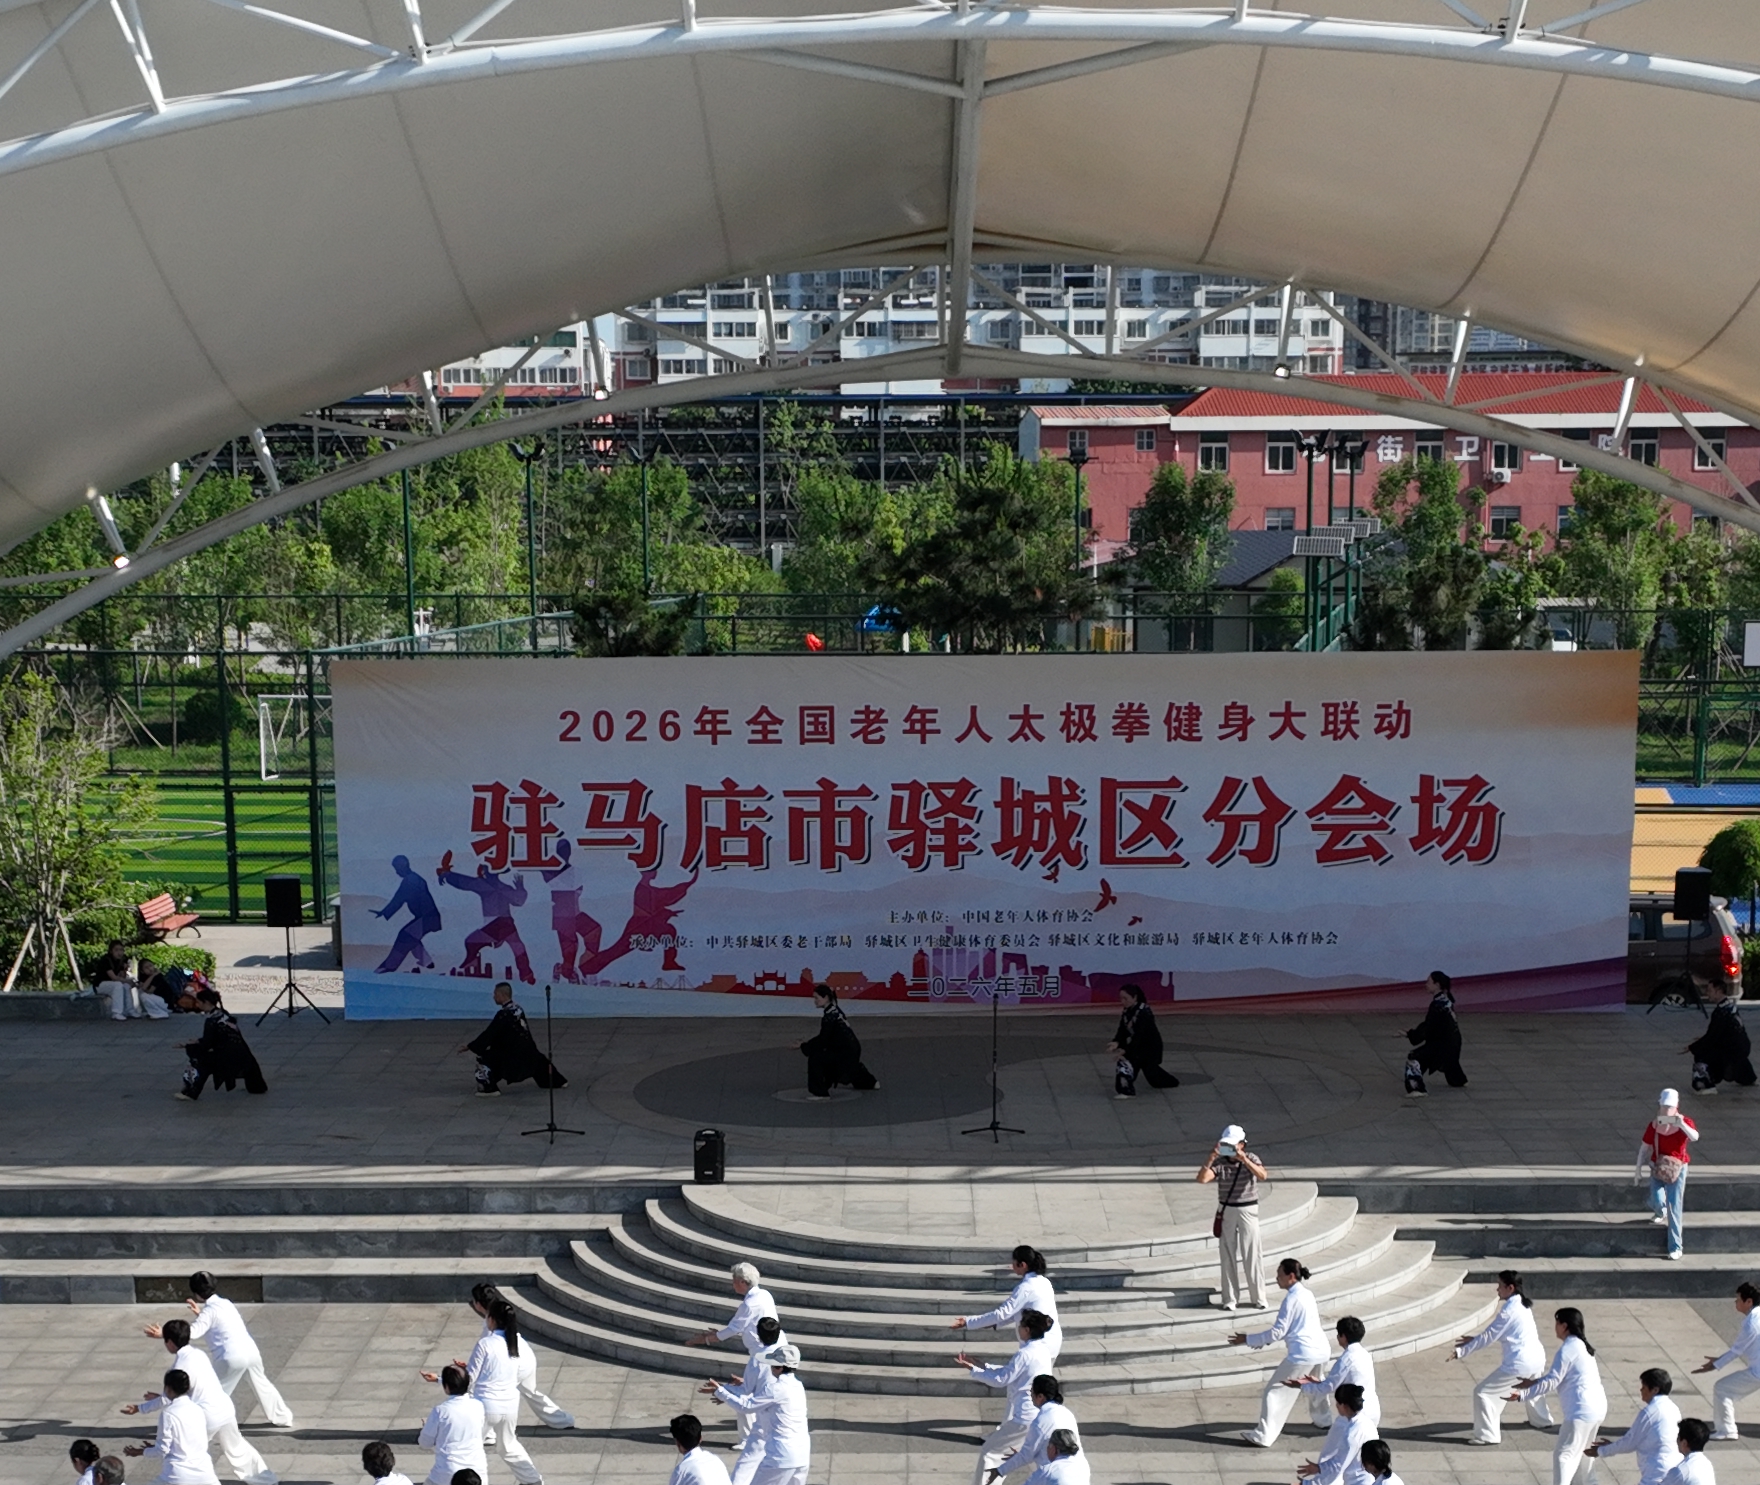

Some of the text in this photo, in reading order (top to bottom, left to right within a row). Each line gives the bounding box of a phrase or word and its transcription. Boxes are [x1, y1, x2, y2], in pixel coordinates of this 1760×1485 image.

[558, 701, 1413, 745] 2026年全国老年人太极拳健身大联动
[469, 773, 1505, 873] 驻马店市驿城区分会场
[889, 909, 1095, 925] 主办单位： 中国老年人体育协会
[705, 934, 853, 951] 中共驿城区委老干部局
[865, 933, 1041, 950] 驿城区卫生健康体育委员会
[1047, 932, 1180, 949] 驿城区文化和旅游局
[1191, 930, 1340, 947] 驿城区老年人体育协会
